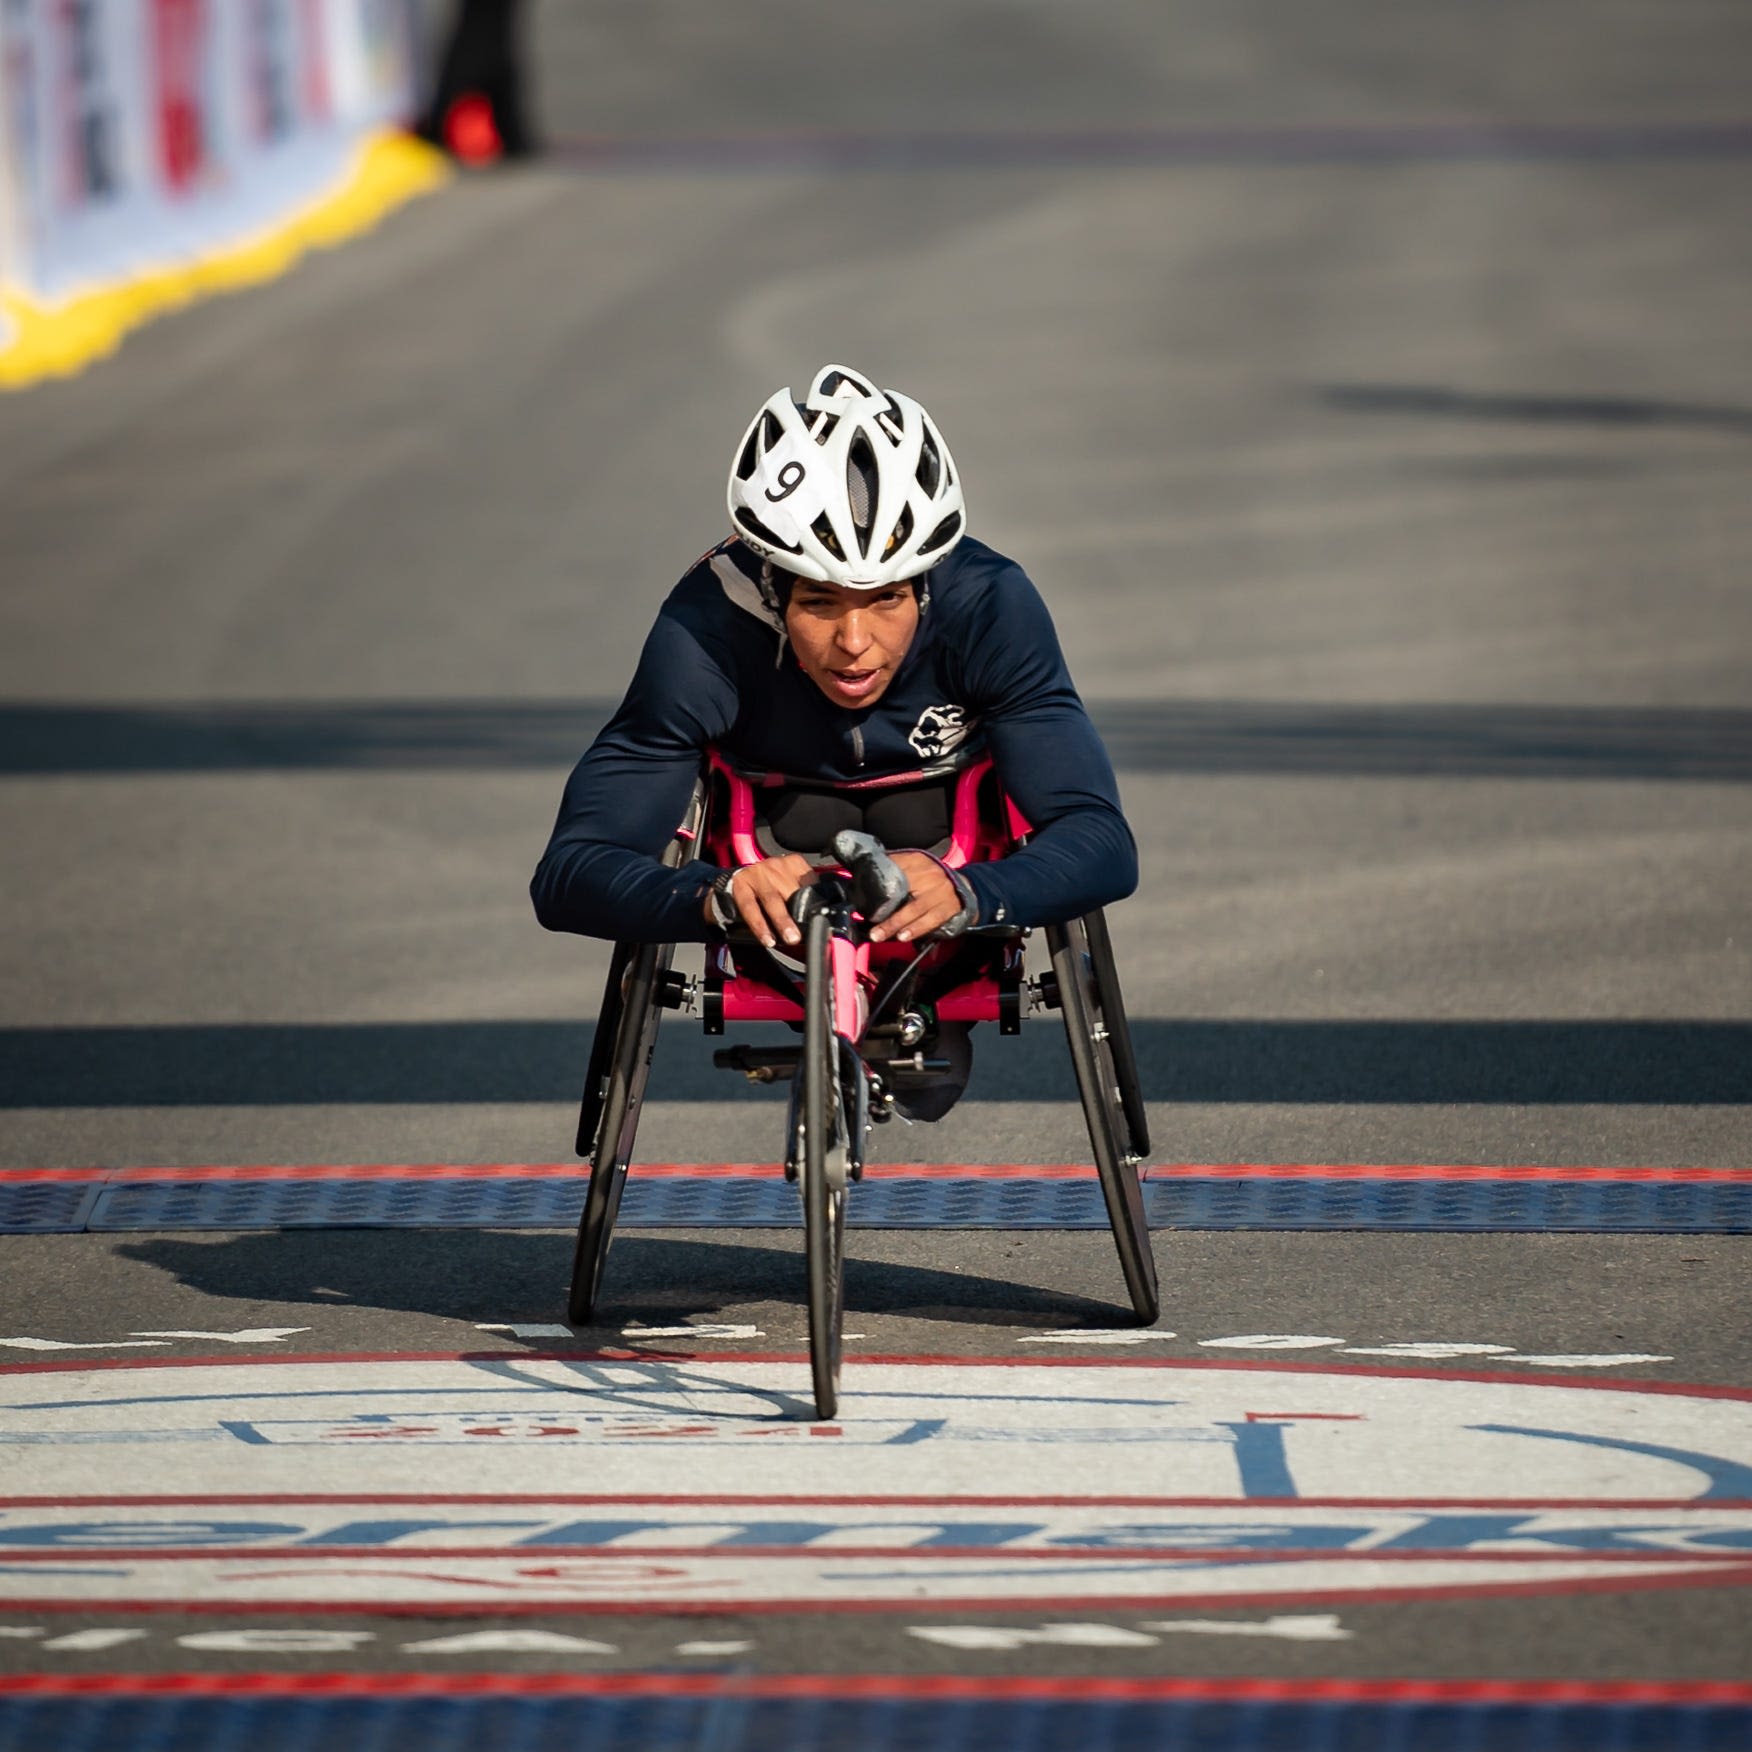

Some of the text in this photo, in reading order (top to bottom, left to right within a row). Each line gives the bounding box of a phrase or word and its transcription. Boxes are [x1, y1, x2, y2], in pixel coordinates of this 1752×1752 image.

[764, 461, 806, 503] 9
[1016, 1329, 1676, 1367] 2024
[320, 1425, 843, 1439] 2024
